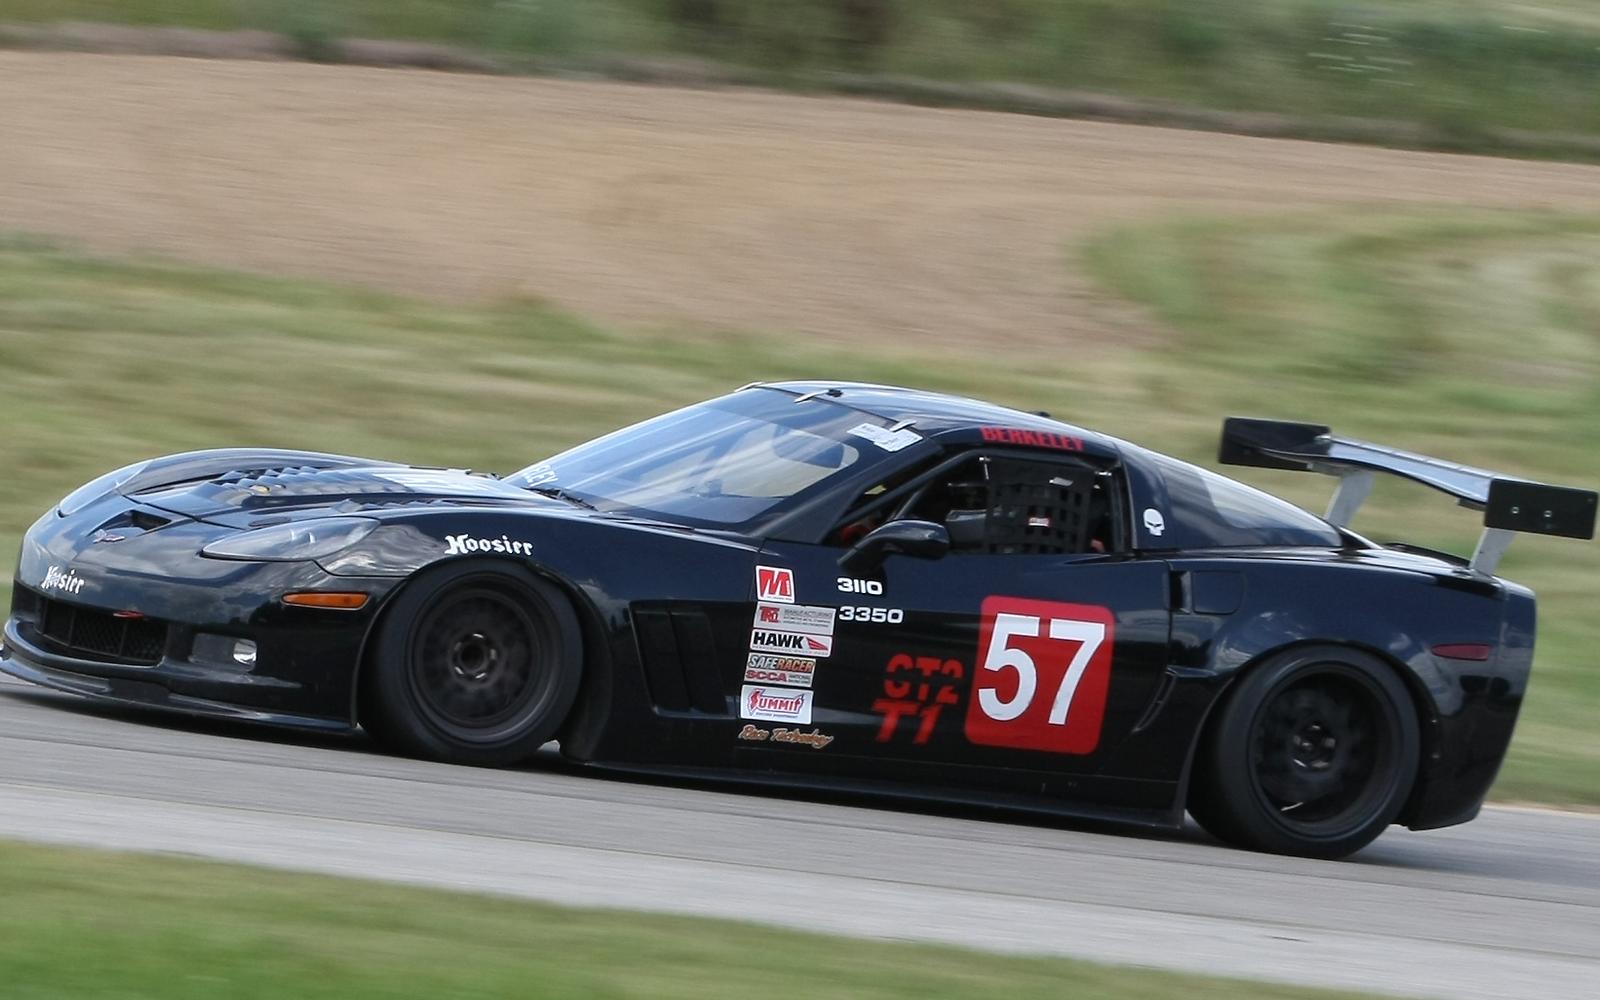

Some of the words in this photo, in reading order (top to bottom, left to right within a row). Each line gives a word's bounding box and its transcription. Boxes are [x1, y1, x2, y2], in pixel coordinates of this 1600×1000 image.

[981, 424, 1085, 451] BERKELEY
[444, 534, 533, 556] Hoosier
[837, 578, 883, 595] 3110
[838, 606, 904, 624] 3350
[753, 631, 804, 649] HAWK
[745, 670, 787, 682] SCCA
[978, 612, 1106, 726] 57
[748, 688, 805, 716] SUMMIT
[872, 698, 947, 744] T1
